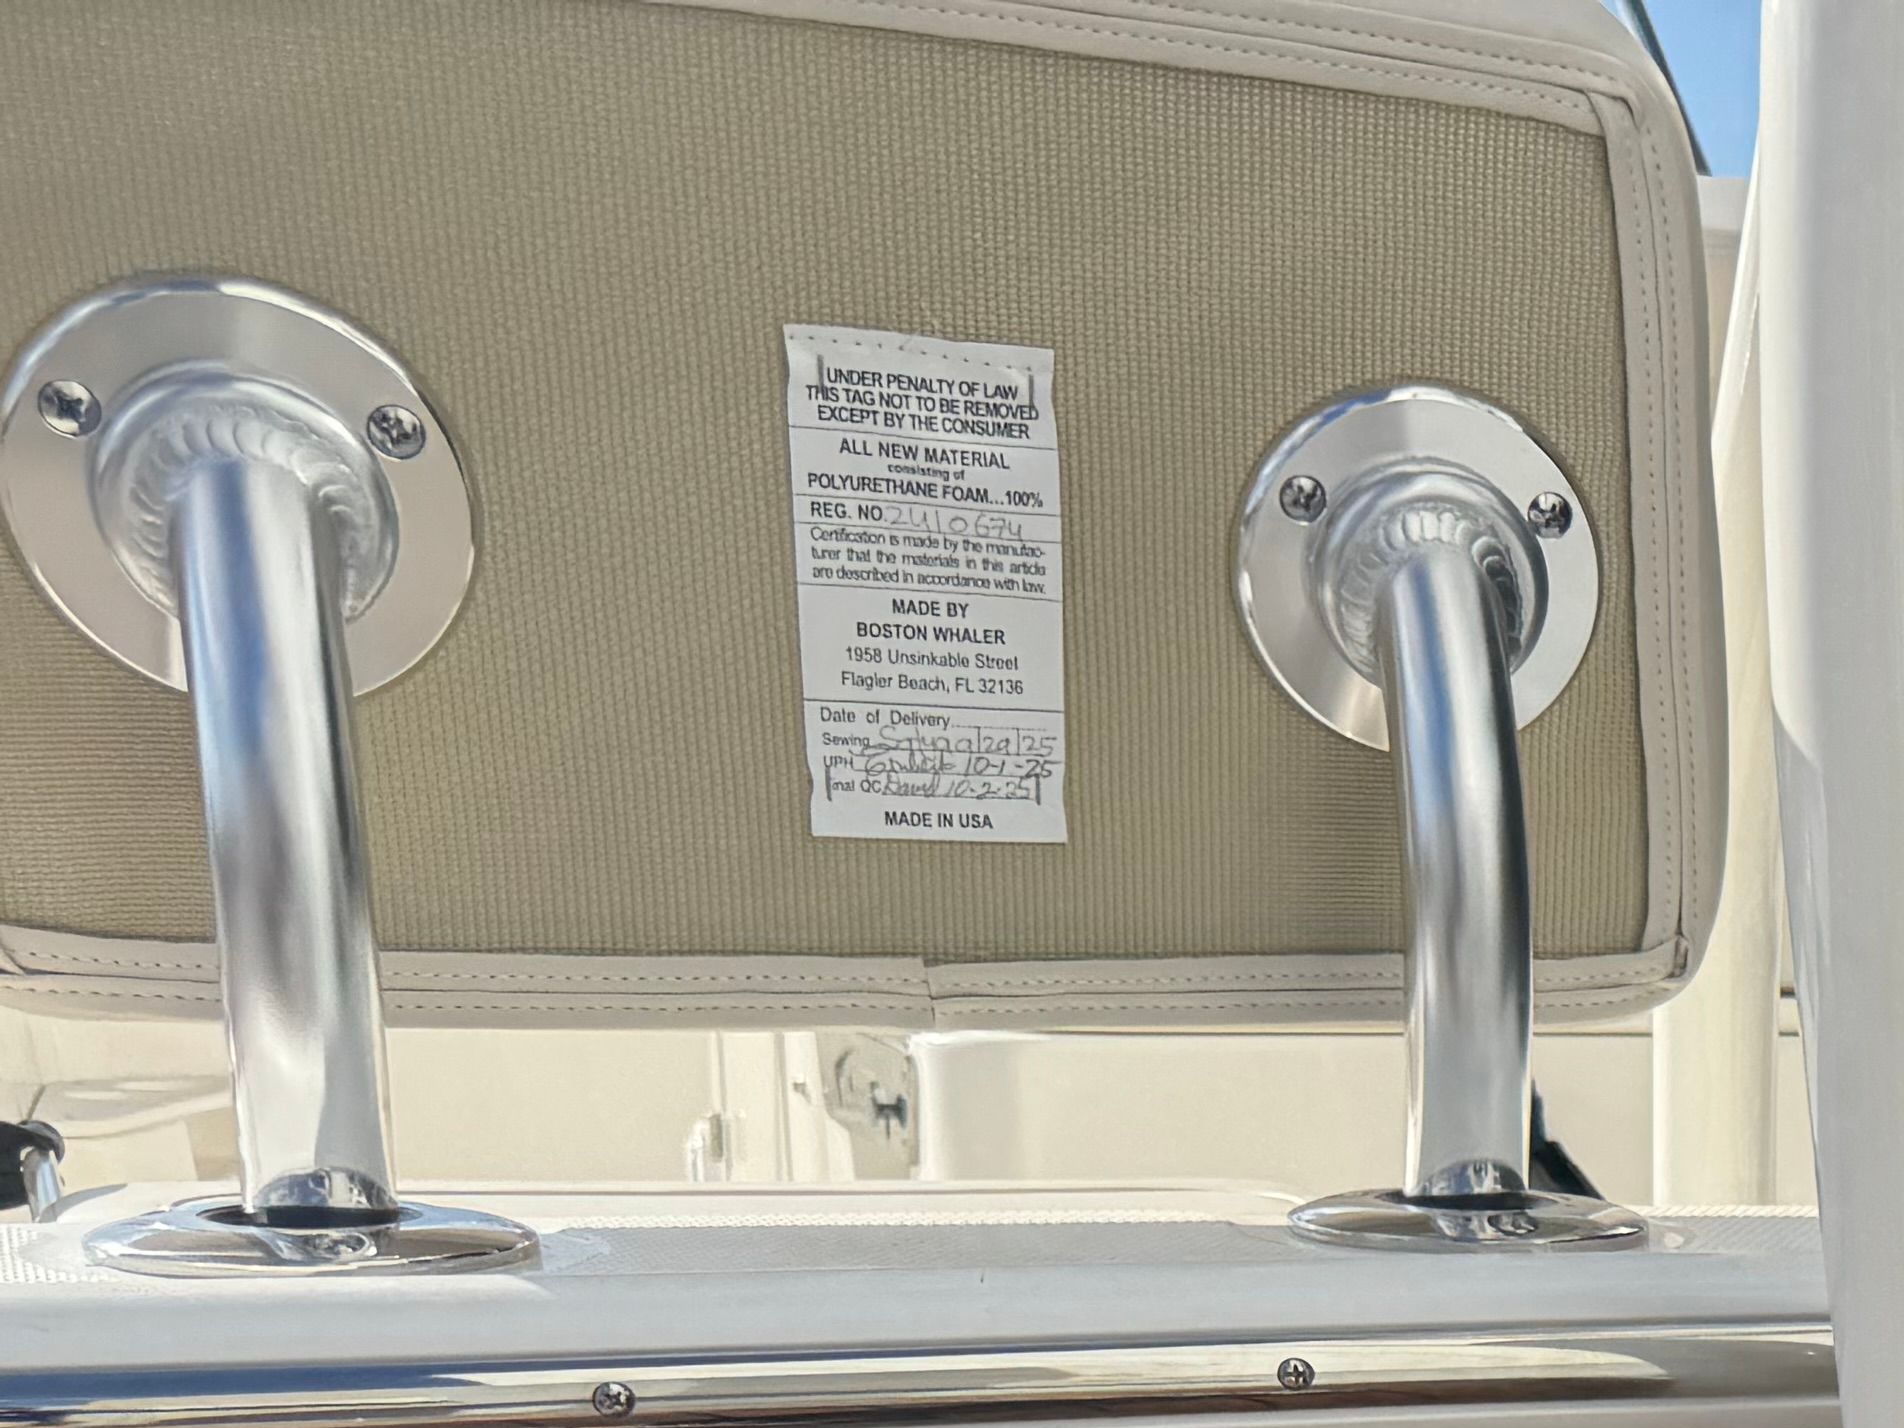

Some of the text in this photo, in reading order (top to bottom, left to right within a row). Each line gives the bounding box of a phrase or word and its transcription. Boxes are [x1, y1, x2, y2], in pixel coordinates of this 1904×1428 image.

[827, 367, 1018, 400] UNDER PENALTY OF LAW
[806, 384, 1038, 420] THIS TAG NOT TO BE REMOVED
[818, 404, 1030, 439] EXCEPT BY THE CONSUMER
[840, 438, 1010, 469] ALL NEW MATERIAL
[888, 464, 965, 481] consisting of
[808, 473, 937, 498] POLYURETHANE
[810, 501, 887, 523] REG. NO.
[810, 526, 885, 545] Certification
[890, 532, 899, 545] is
[903, 534, 938, 549] made
[944, 536, 958, 552] by
[963, 538, 982, 552] the
[812, 546, 1045, 575] turer that the materials in this article
[813, 567, 1046, 594] are described in accordance with law.
[892, 599, 969, 618] MADE BY
[856, 622, 1005, 645] BOSTON WHALER
[846, 646, 1018, 670] 1958 Unsinkable Street
[841, 671, 1023, 695] Flagler Beach, FL 32136
[821, 707, 950, 730] Date of Delivery
[822, 732, 870, 749] Sewing
[824, 755, 853, 768] UPH
[860, 779, 882, 792] QC
[885, 810, 993, 829] MADE IN USA
